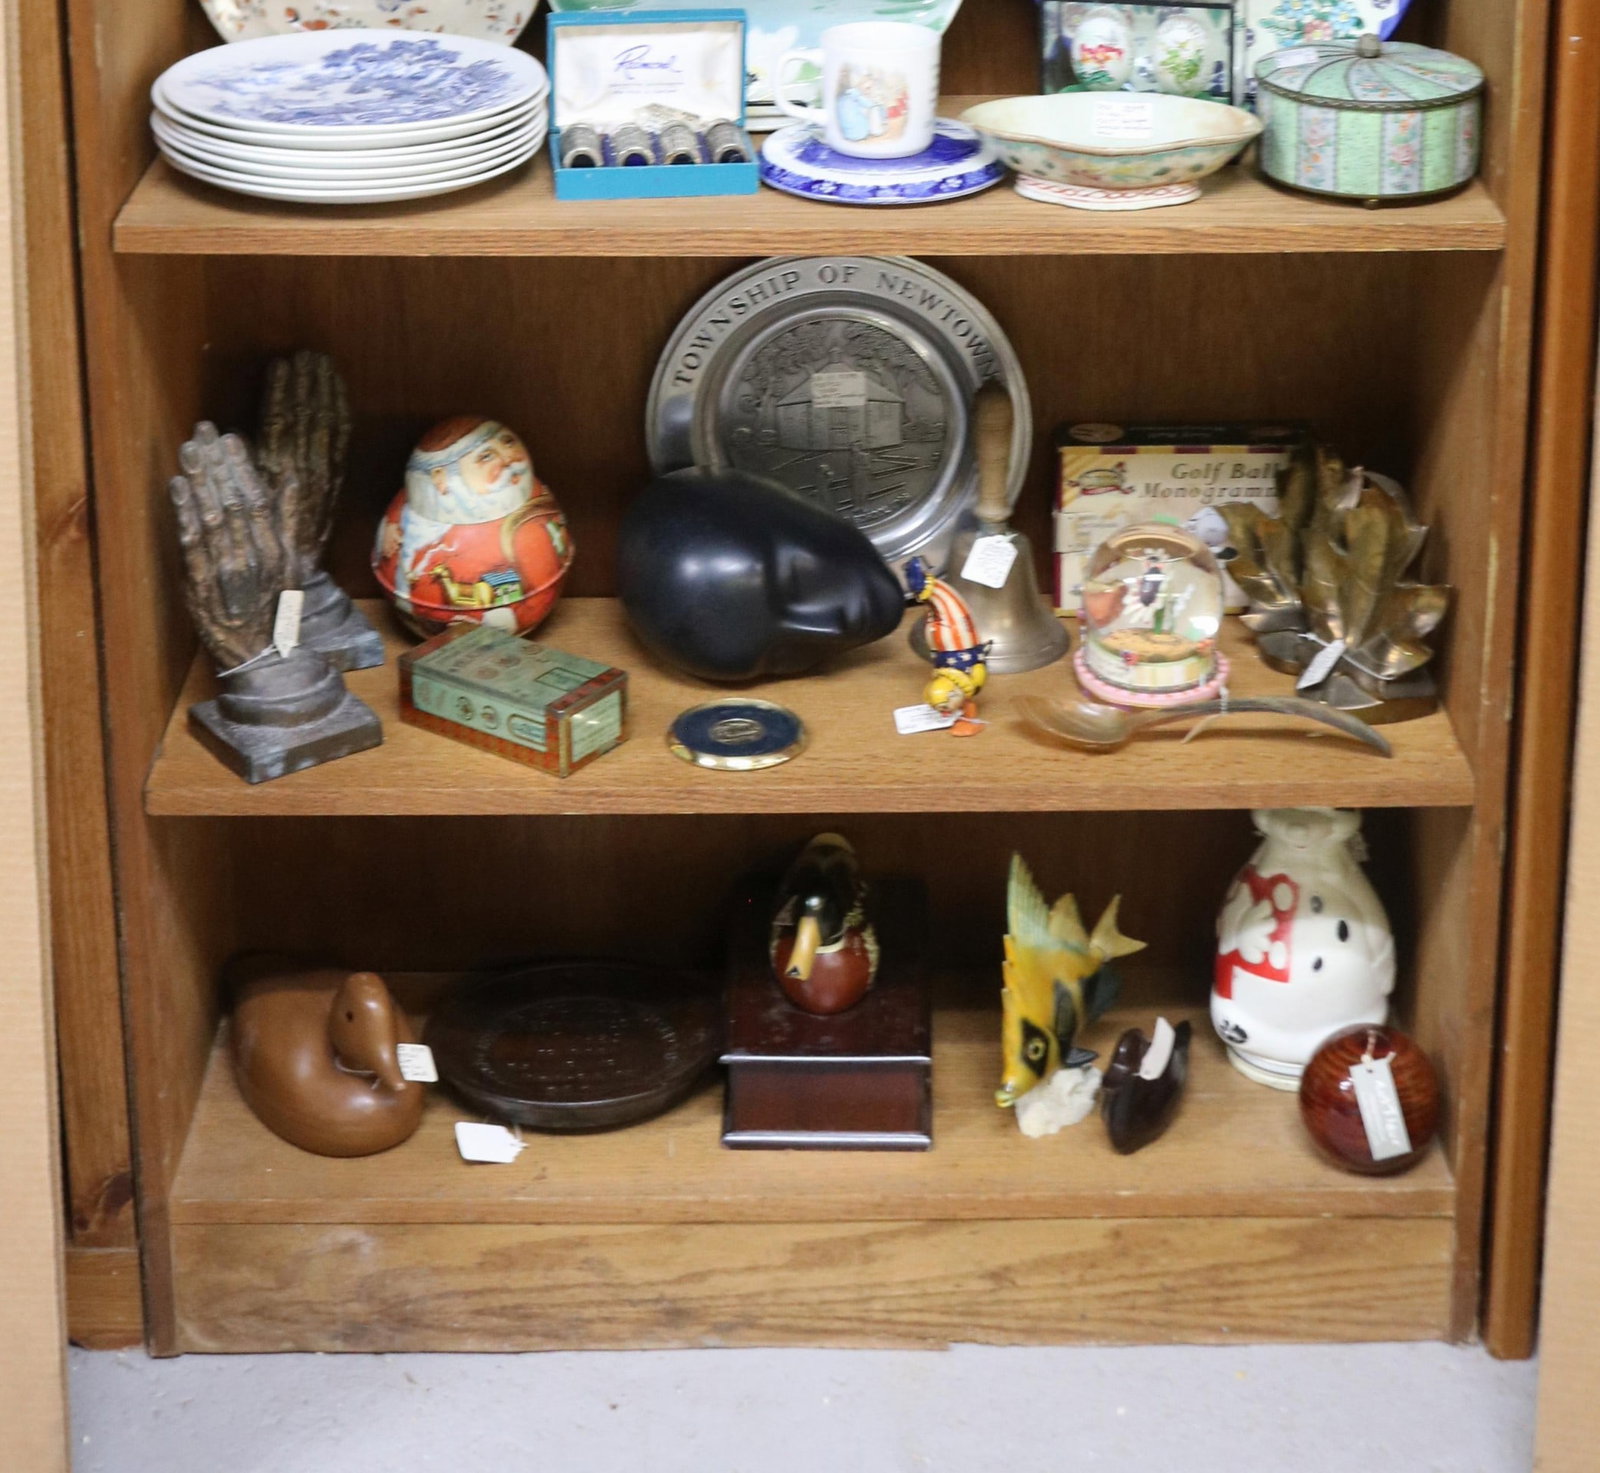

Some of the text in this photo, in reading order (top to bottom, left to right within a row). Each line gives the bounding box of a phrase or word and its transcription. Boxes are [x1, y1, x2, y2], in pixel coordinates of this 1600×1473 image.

[671, 264, 1000, 387] TOWNSHIP OF NEWTOWN
[1171, 462, 1226, 486] Golf
